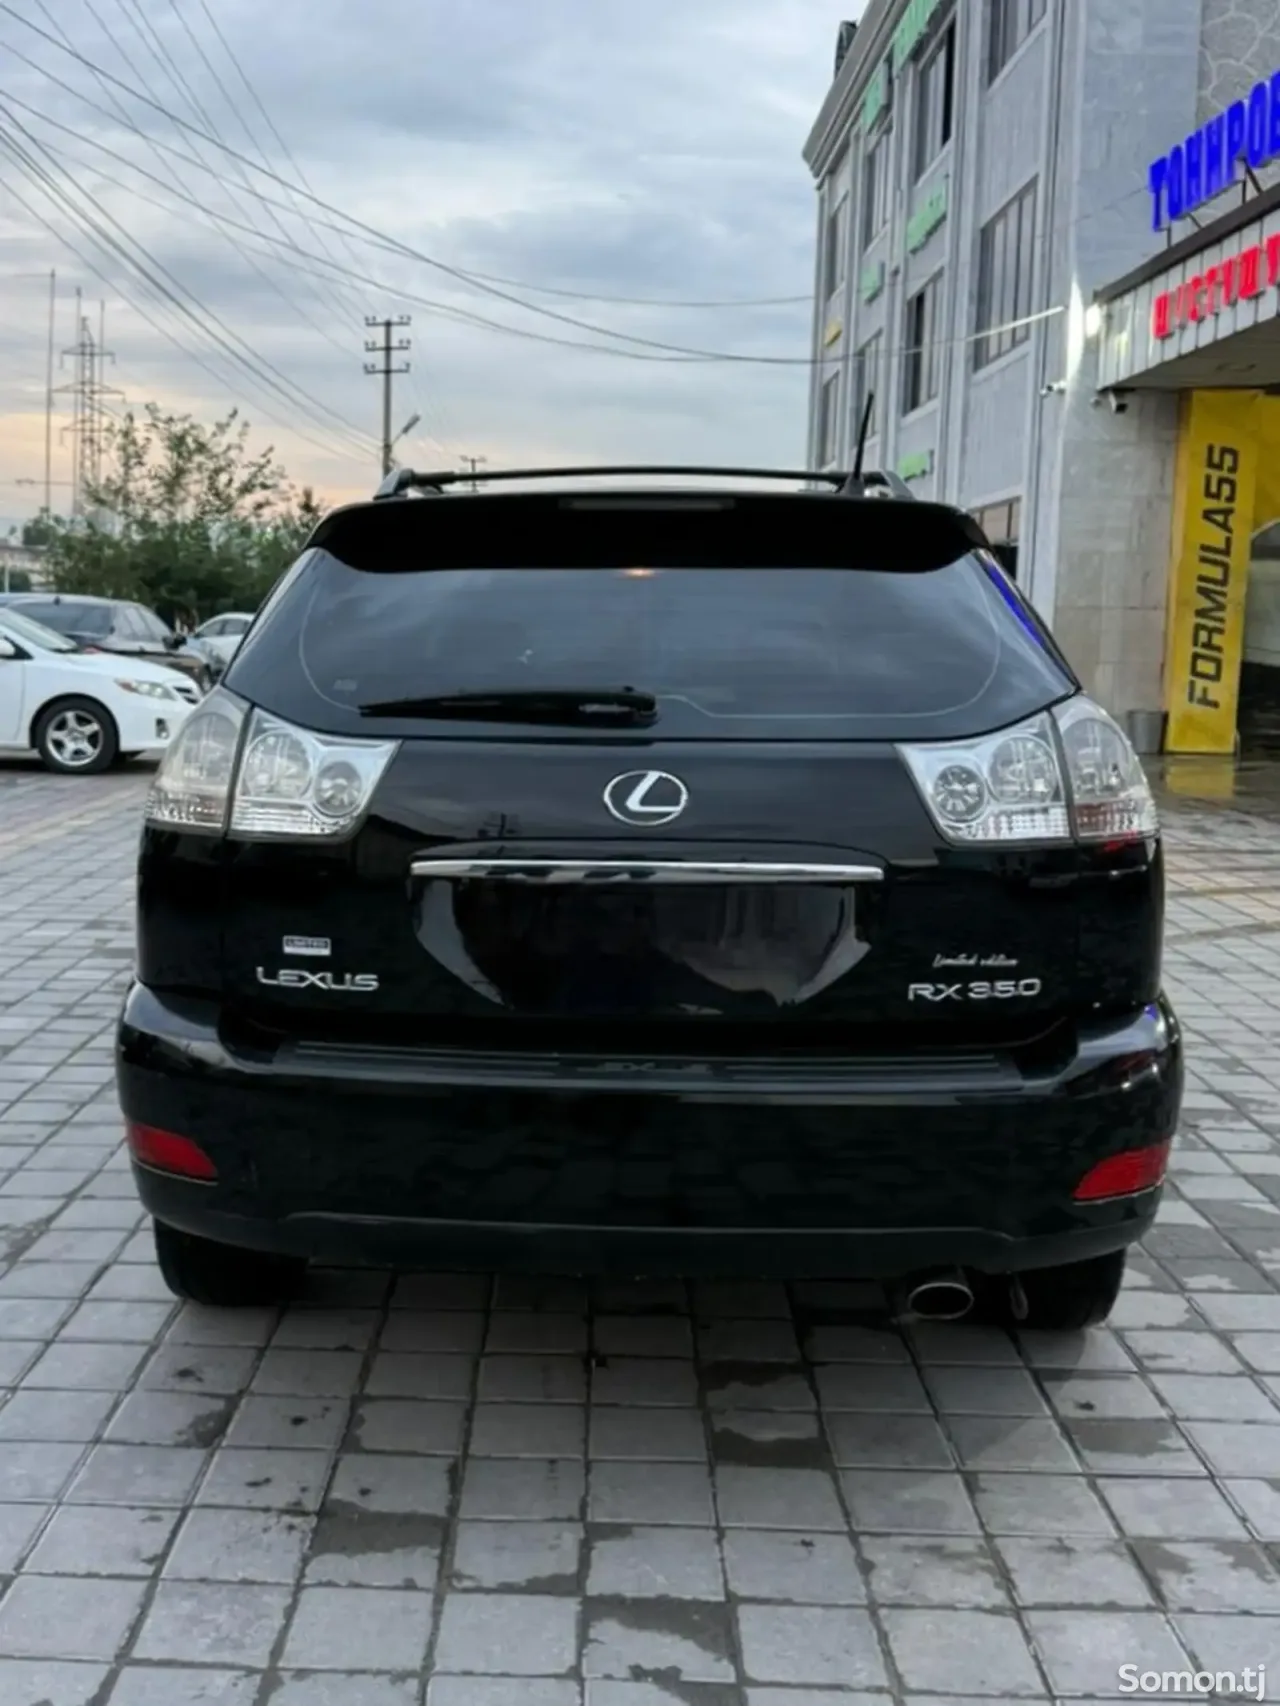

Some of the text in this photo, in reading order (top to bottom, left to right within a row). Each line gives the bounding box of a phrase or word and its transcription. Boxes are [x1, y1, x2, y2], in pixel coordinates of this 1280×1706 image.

[1188, 443, 1240, 709] FORMULA55
[256, 966, 379, 991] LEXUS
[907, 978, 1042, 1001] RX 350
